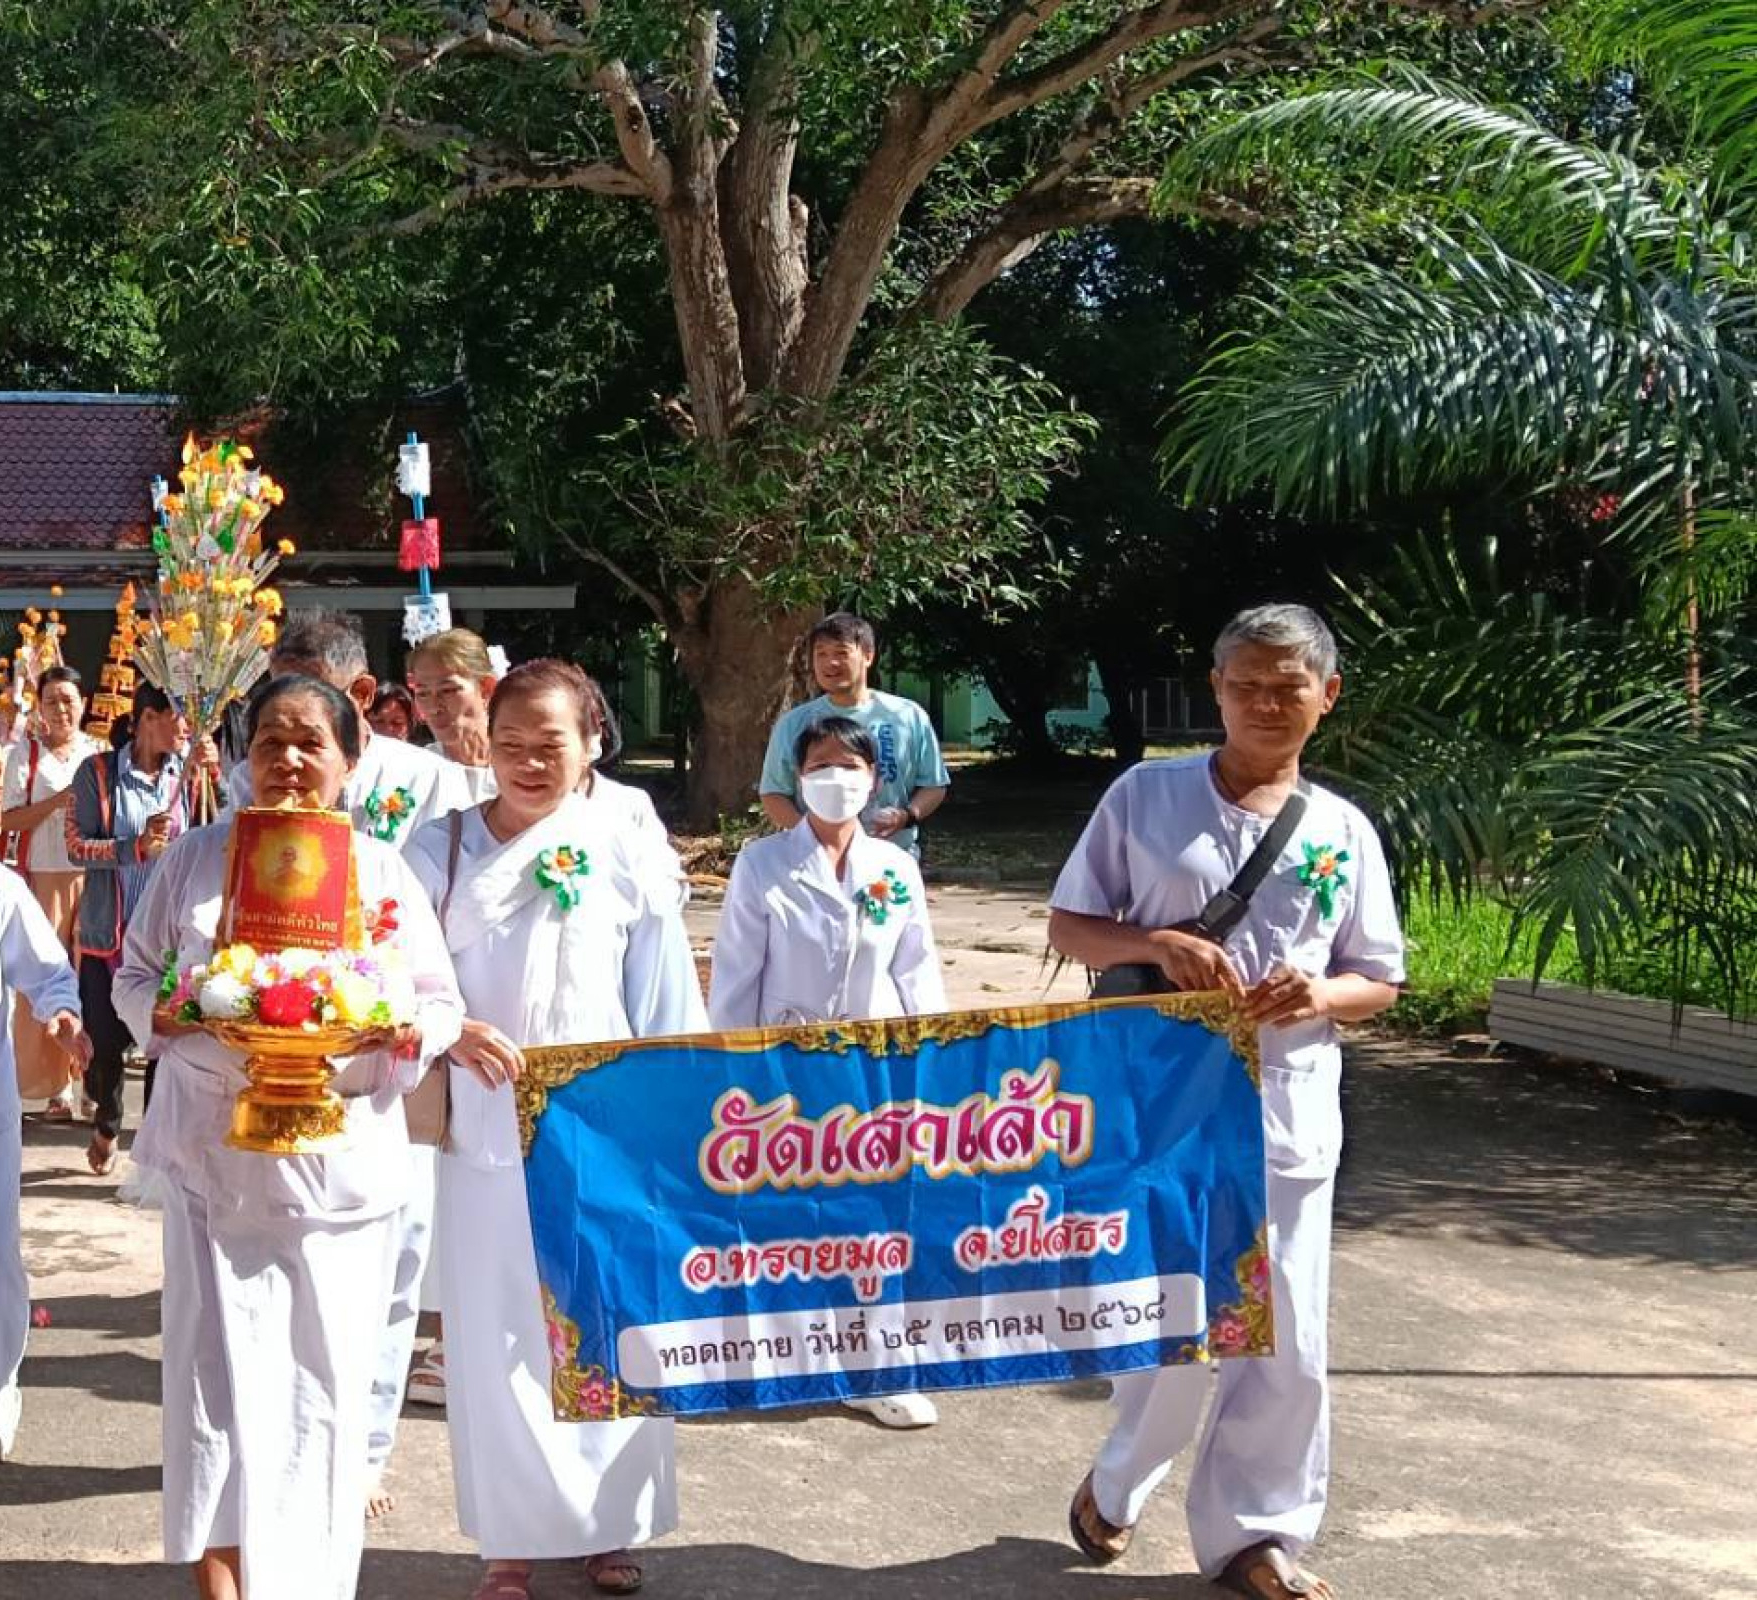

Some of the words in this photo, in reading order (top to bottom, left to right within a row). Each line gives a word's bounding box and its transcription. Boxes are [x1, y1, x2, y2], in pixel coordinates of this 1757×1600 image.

[704, 1066, 1087, 1184] วัดเสาเล้า
[685, 1235, 911, 1299] อ.ทรายมูล
[958, 1193, 1126, 1266] จ.ยโสธร
[658, 1331, 794, 1369] ทอดถวาย
[805, 1309, 868, 1358] วันที่
[878, 1318, 932, 1351] ๒๕
[943, 1311, 1044, 1353] ตุลาคม
[1057, 1293, 1167, 1334] ๒๕๖๘
